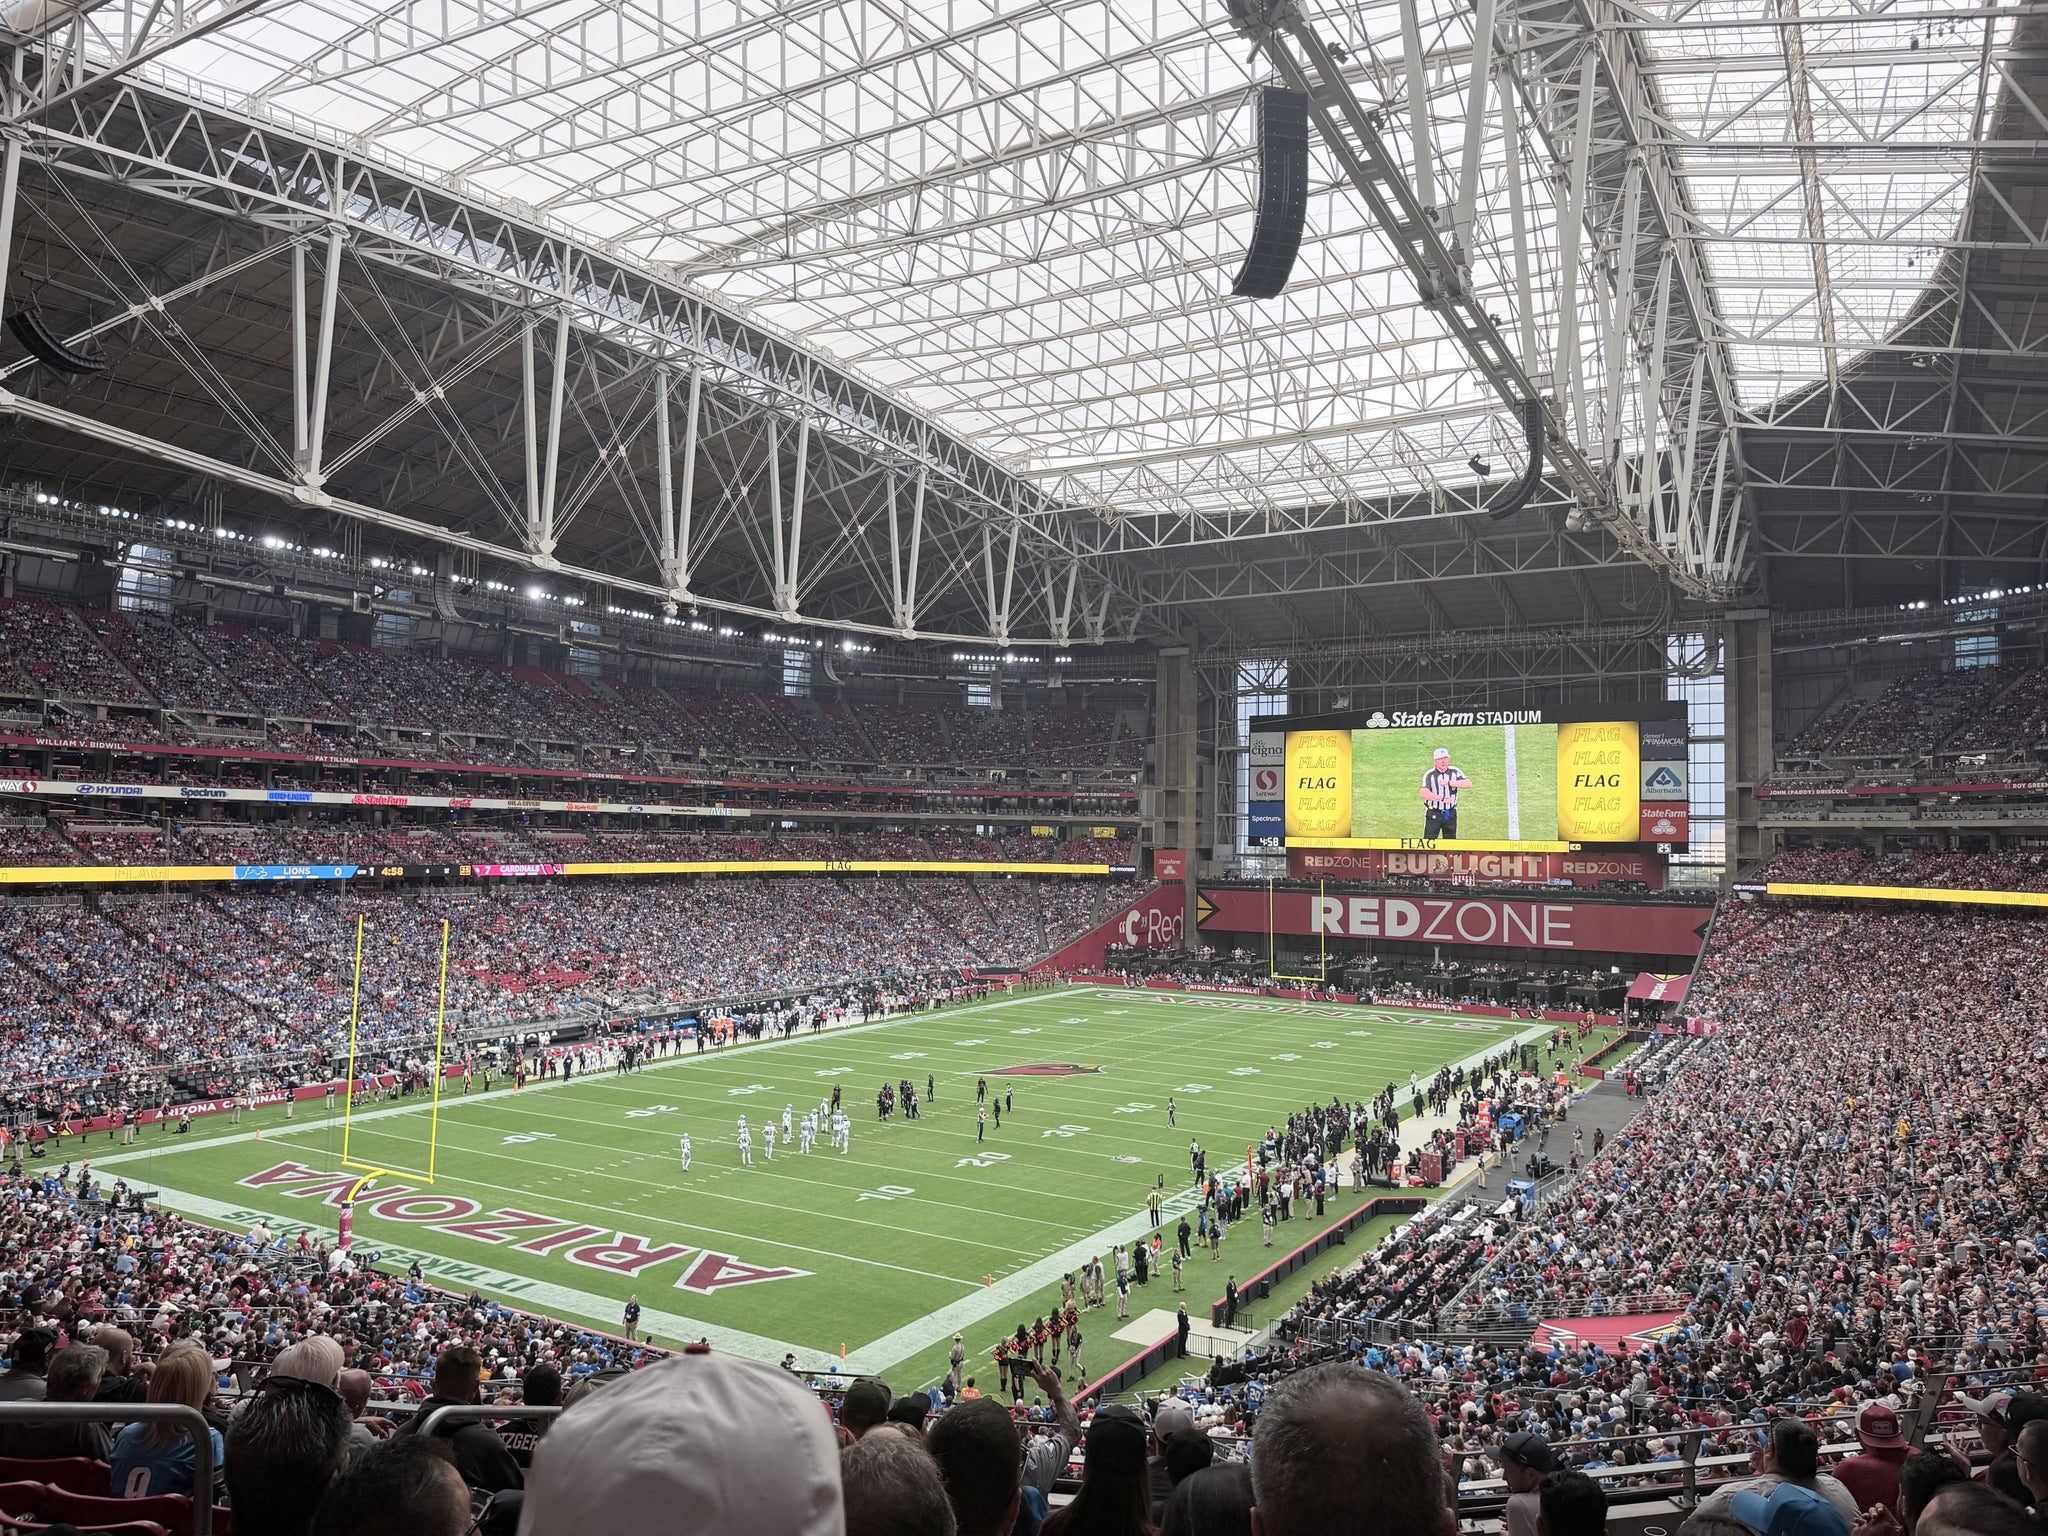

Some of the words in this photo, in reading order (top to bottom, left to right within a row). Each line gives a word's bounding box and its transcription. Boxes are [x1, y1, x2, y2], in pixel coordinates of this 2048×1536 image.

[1476, 710, 1542, 725] STADIUM
[1573, 727, 1621, 742] FLAG
[36, 738, 77, 747] WILLIAM
[90, 742, 128, 750] BIDWILL
[1298, 735, 1337, 748] FLAG
[1251, 744, 1283, 757] cigna
[1298, 756, 1337, 768] FLAG
[1573, 751, 1621, 765] FLAG
[1298, 777, 1337, 789] FLAG
[1574, 774, 1620, 788] FLAG
[96, 785, 143, 795] HYUNDAI
[180, 787, 227, 799] Spectrum
[287, 793, 312, 802] LIGHT
[1298, 798, 1337, 810] FLAG
[1573, 797, 1621, 811] FLAG
[710, 807, 735, 817] AVNET
[1251, 815, 1280, 823] Spectrum
[1298, 820, 1337, 831] FLAG
[1573, 821, 1621, 835] FLAG
[1260, 837, 1279, 847] 4:58
[1401, 838, 1436, 849] FLAG
[1658, 844, 1670, 853] 25
[500, 864, 541, 874] CARDINALS
[825, 861, 852, 871] FLAG
[1304, 856, 1371, 869] REDZONE
[1388, 853, 1449, 874] BUD
[1453, 855, 1542, 878] LIGHT
[1563, 861, 1643, 876] REDZONE
[283, 867, 311, 875] LIONS
[334, 867, 342, 877] 0
[369, 867, 375, 877] 1
[381, 867, 404, 877] 4:58
[485, 866, 492, 875] 7
[1147, 907, 1184, 944] Red
[1311, 896, 1574, 947] REDZONE
[1377, 999, 1413, 1008] ARIZOA
[1416, 1003, 1463, 1011] CARDINLS
[1097, 993, 1501, 1031] CARDINALS
[1173, 1083, 1213, 1093] 50
[624, 1105, 679, 1119] 20
[1113, 1102, 1157, 1114] 40
[1041, 1124, 1092, 1138] 30
[500, 1131, 557, 1145] 10
[954, 1151, 1013, 1168] 20
[1393, 1166, 1400, 1174] G
[856, 1185, 917, 1202] 10
[220, 1210, 275, 1225] US
[235, 1160, 817, 1295] ARIZONA
[269, 1222, 318, 1236] OF
[318, 1230, 386, 1251] AL
[381, 1248, 491, 1282] TAKES
[483, 1277, 538, 1293] IT
